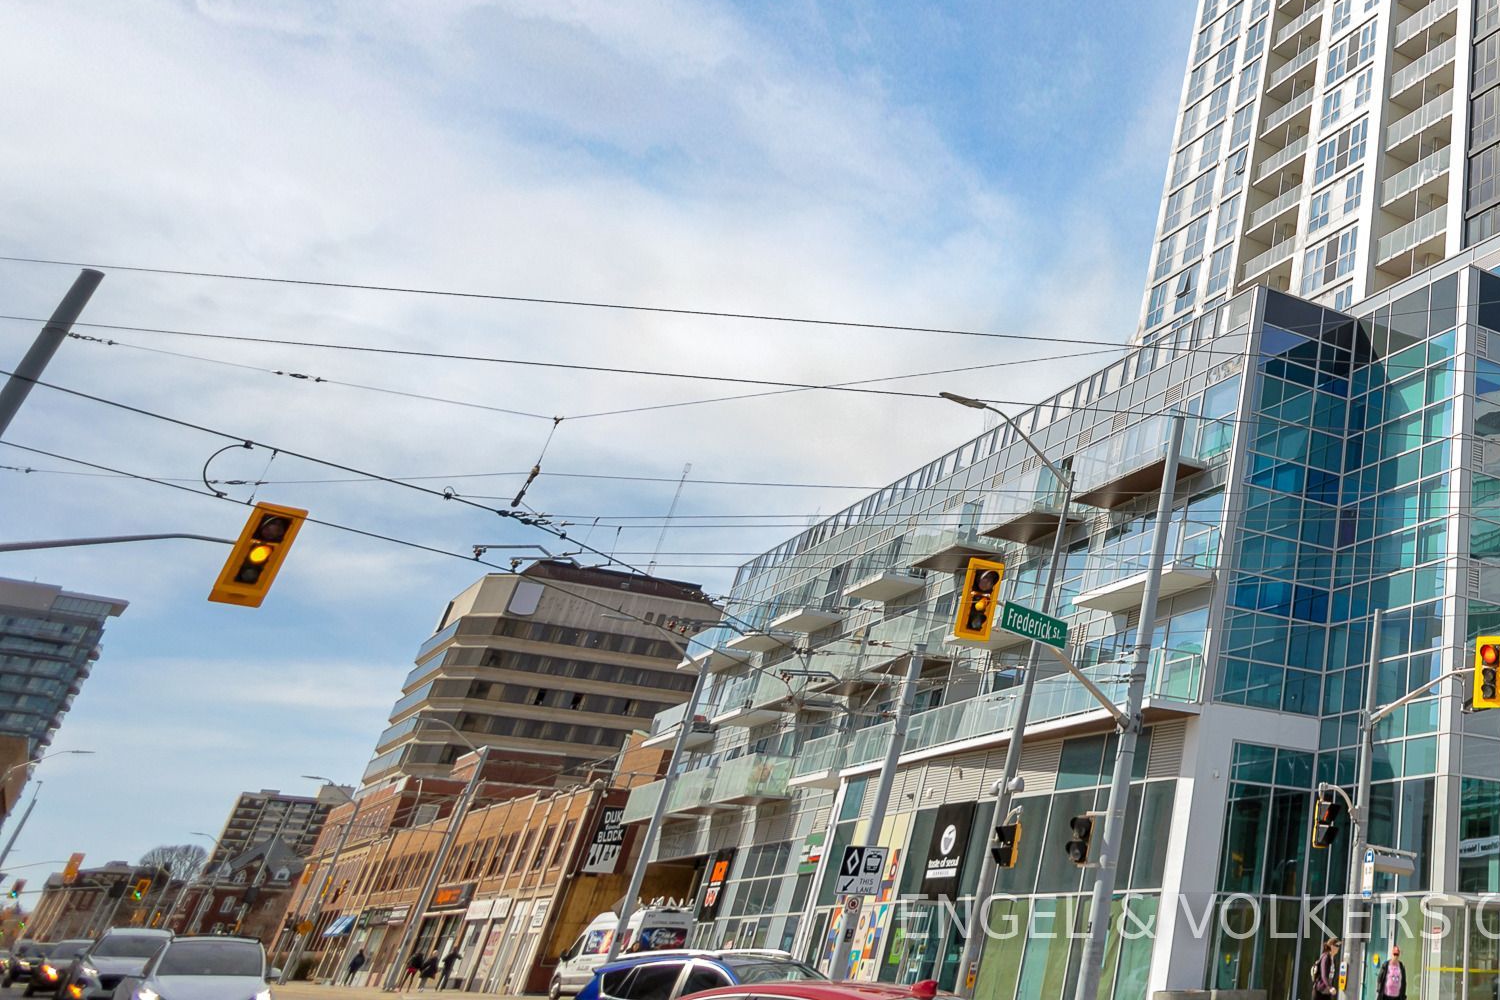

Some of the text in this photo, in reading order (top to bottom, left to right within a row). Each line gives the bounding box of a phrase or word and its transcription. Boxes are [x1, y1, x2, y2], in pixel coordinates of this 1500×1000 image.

[1007, 608, 1061, 640] Frederick St.
[605, 810, 623, 824] DUK
[597, 829, 623, 842] BLOCK
[940, 857, 947, 868] of
[860, 878, 874, 886] THIS
[856, 886, 872, 894] LANE
